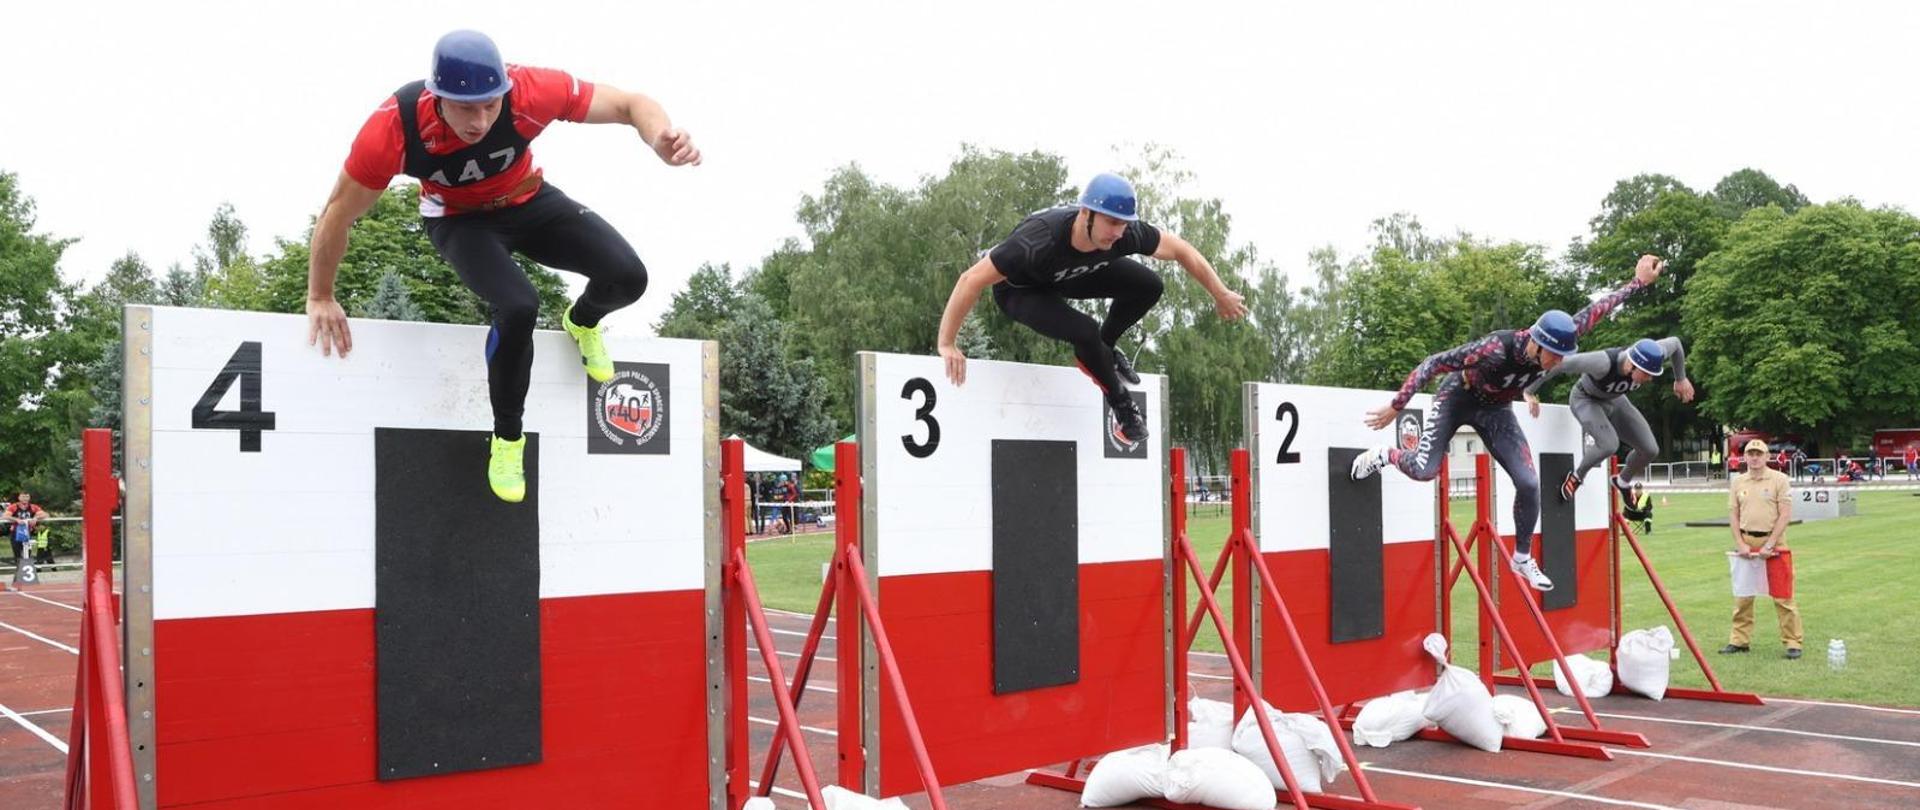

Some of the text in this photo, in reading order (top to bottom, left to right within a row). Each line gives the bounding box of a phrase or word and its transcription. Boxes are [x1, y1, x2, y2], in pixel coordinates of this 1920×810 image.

[192, 342, 275, 452] 4
[618, 396, 640, 422] 40
[901, 378, 940, 458] 3
[1276, 402, 1300, 463] 2
[1803, 491, 1812, 502] 2
[22, 565, 35, 582] 3
